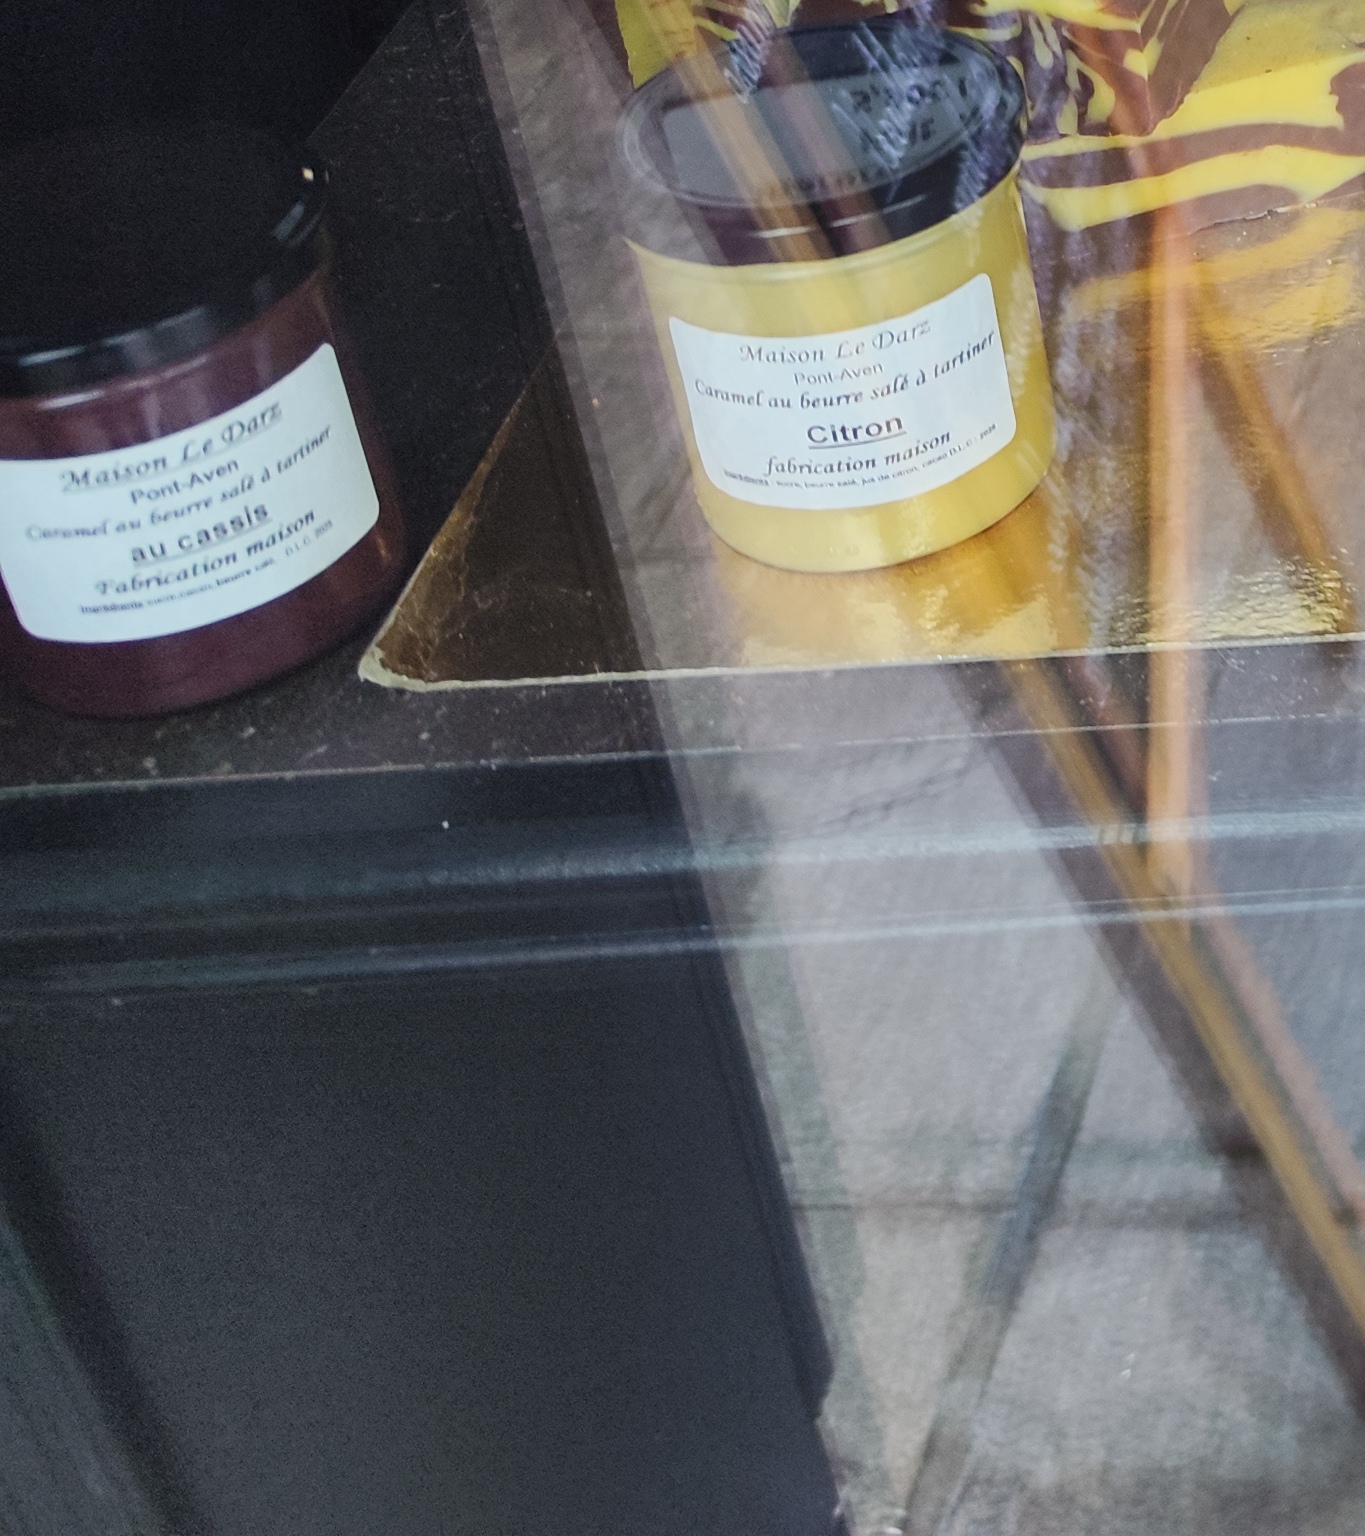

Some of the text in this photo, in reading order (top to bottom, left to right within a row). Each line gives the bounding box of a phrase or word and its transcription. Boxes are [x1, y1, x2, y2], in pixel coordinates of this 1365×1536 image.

[738, 320, 932, 364] Maison Le Darz
[694, 379, 763, 407] Caramel
[767, 396, 791, 409] au
[799, 391, 864, 409] beurre
[869, 374, 909, 400] salé
[933, 330, 995, 380] tartiner
[794, 361, 884, 385] Pont-Aven
[61, 403, 282, 488] Maison Le Darz
[763, 455, 877, 477] fabrication
[885, 430, 951, 465] maison
[807, 414, 904, 444] Citron
[26, 519, 108, 541] Caramel
[115, 517, 141, 533] au
[150, 498, 213, 527] beurre
[220, 477, 255, 503] salé
[277, 425, 332, 473] tartiner
[130, 460, 240, 504] Pont-Aven
[95, 550, 238, 596] Fabrication
[246, 508, 316, 556] maison
[131, 541, 167, 563] au
[177, 501, 269, 550] cassis
